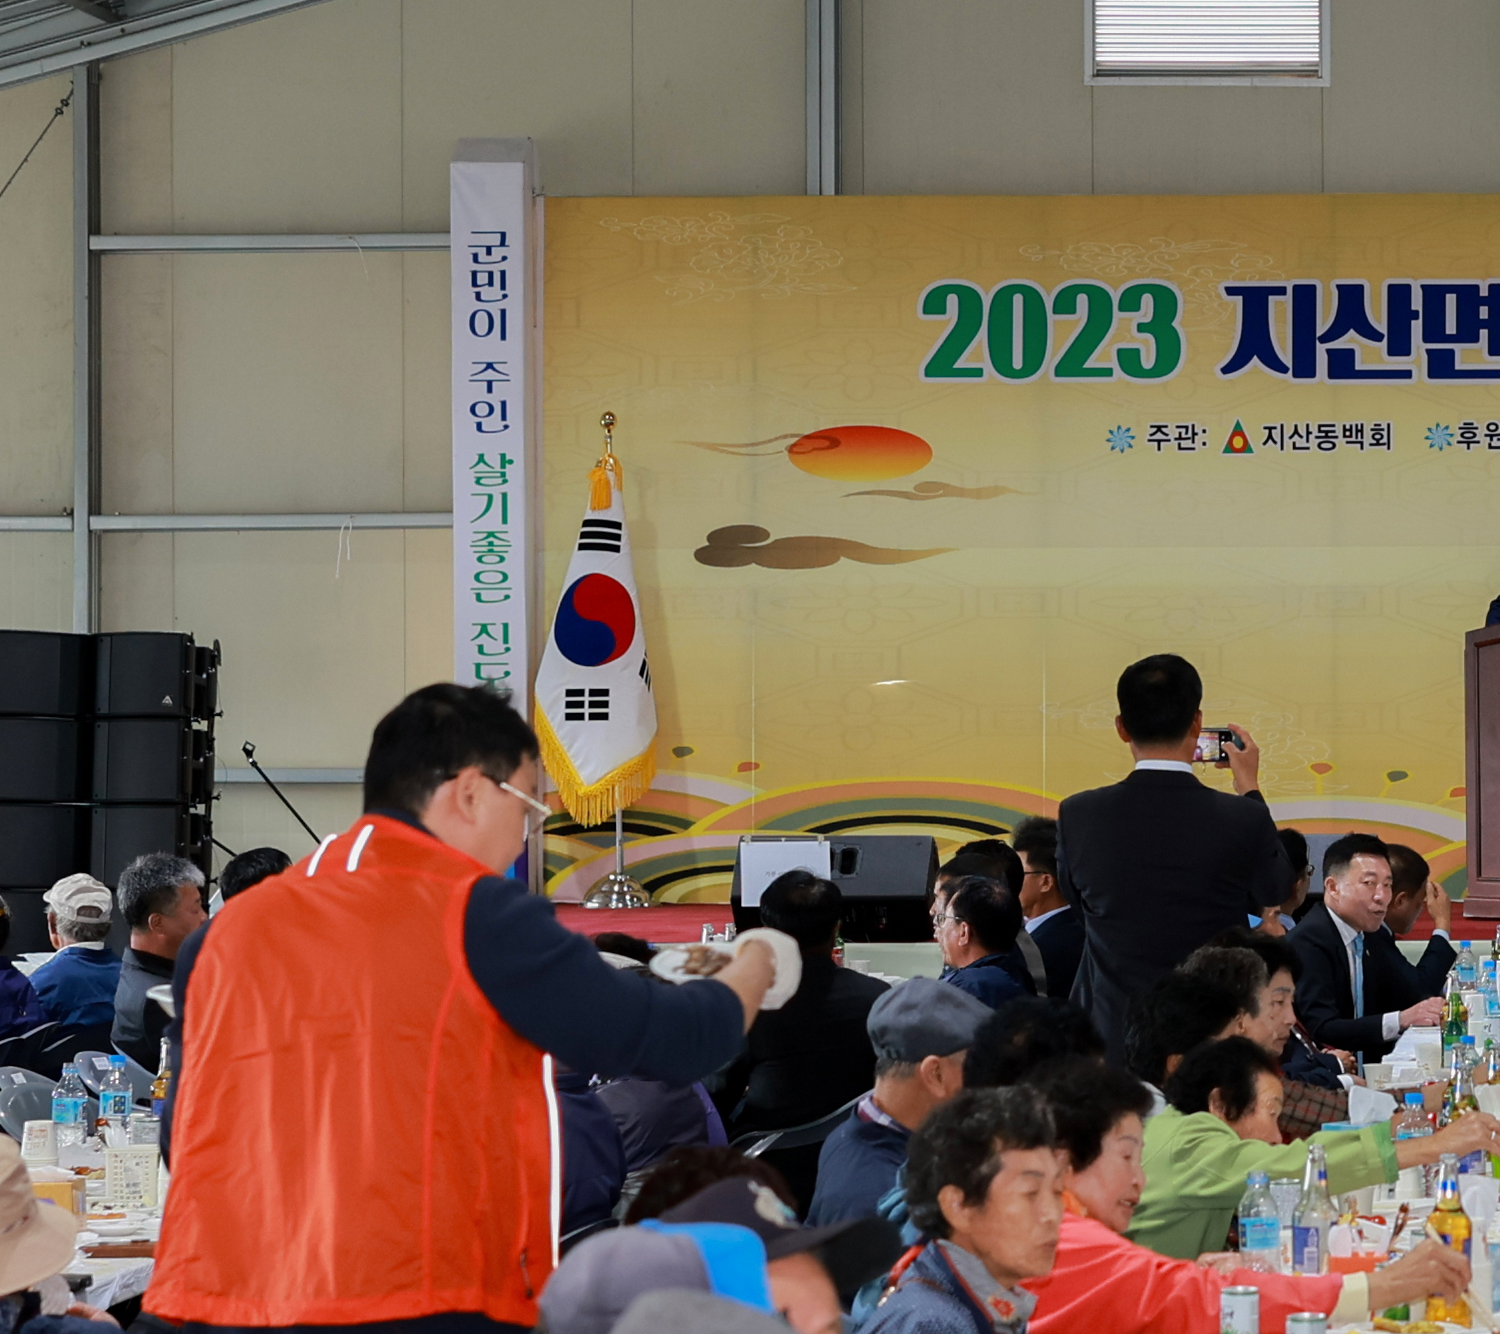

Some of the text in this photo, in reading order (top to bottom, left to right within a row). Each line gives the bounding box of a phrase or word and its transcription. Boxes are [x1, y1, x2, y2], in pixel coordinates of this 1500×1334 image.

[467, 230, 511, 342] 군민이
[921, 281, 1183, 380] 2023
[468, 361, 511, 435] 주인
[1145, 422, 1208, 451] 주관:
[1261, 421, 1393, 451] 지산동백회
[468, 452, 515, 605] 살기좋은
